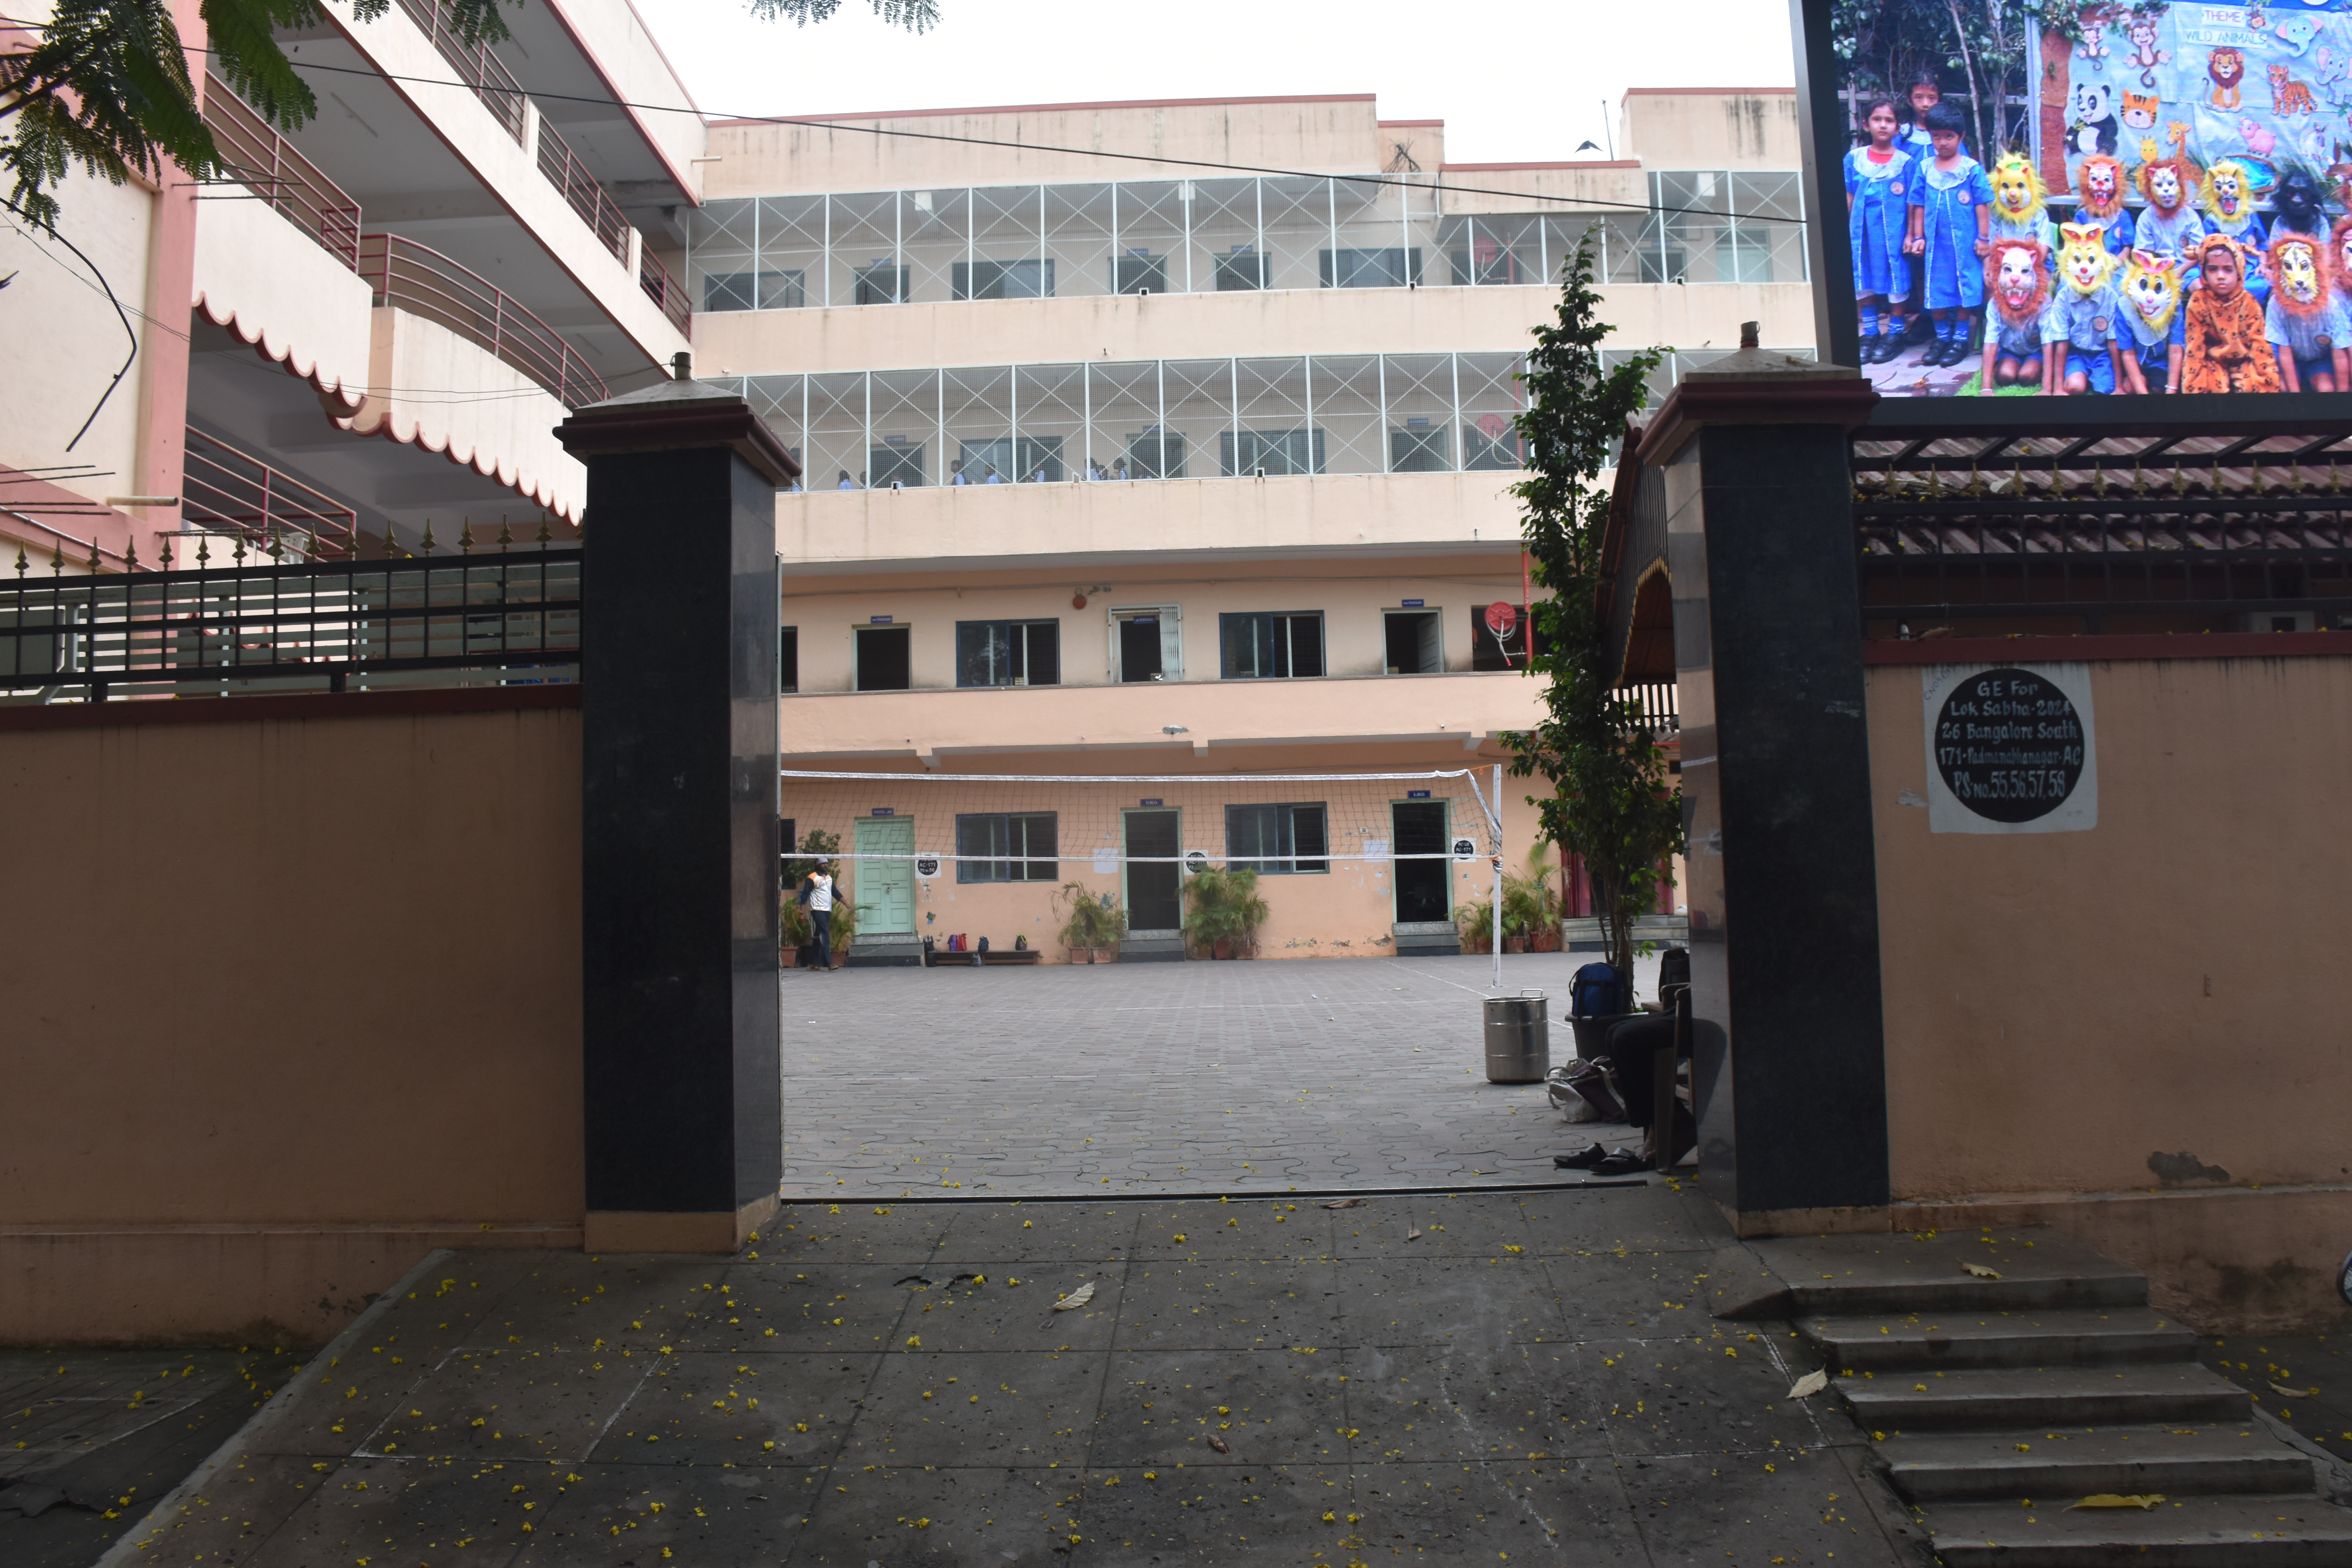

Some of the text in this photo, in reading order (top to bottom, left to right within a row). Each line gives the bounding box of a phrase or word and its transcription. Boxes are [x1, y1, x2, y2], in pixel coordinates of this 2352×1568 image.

[2205, 10, 2241, 22] THEME
[2217, 32, 2267, 44] ANIMALS
[1977, 680, 2038, 697] GE For
[1951, 701, 1978, 716] Lok
[1942, 720, 2077, 744] 26 Bangalore South
